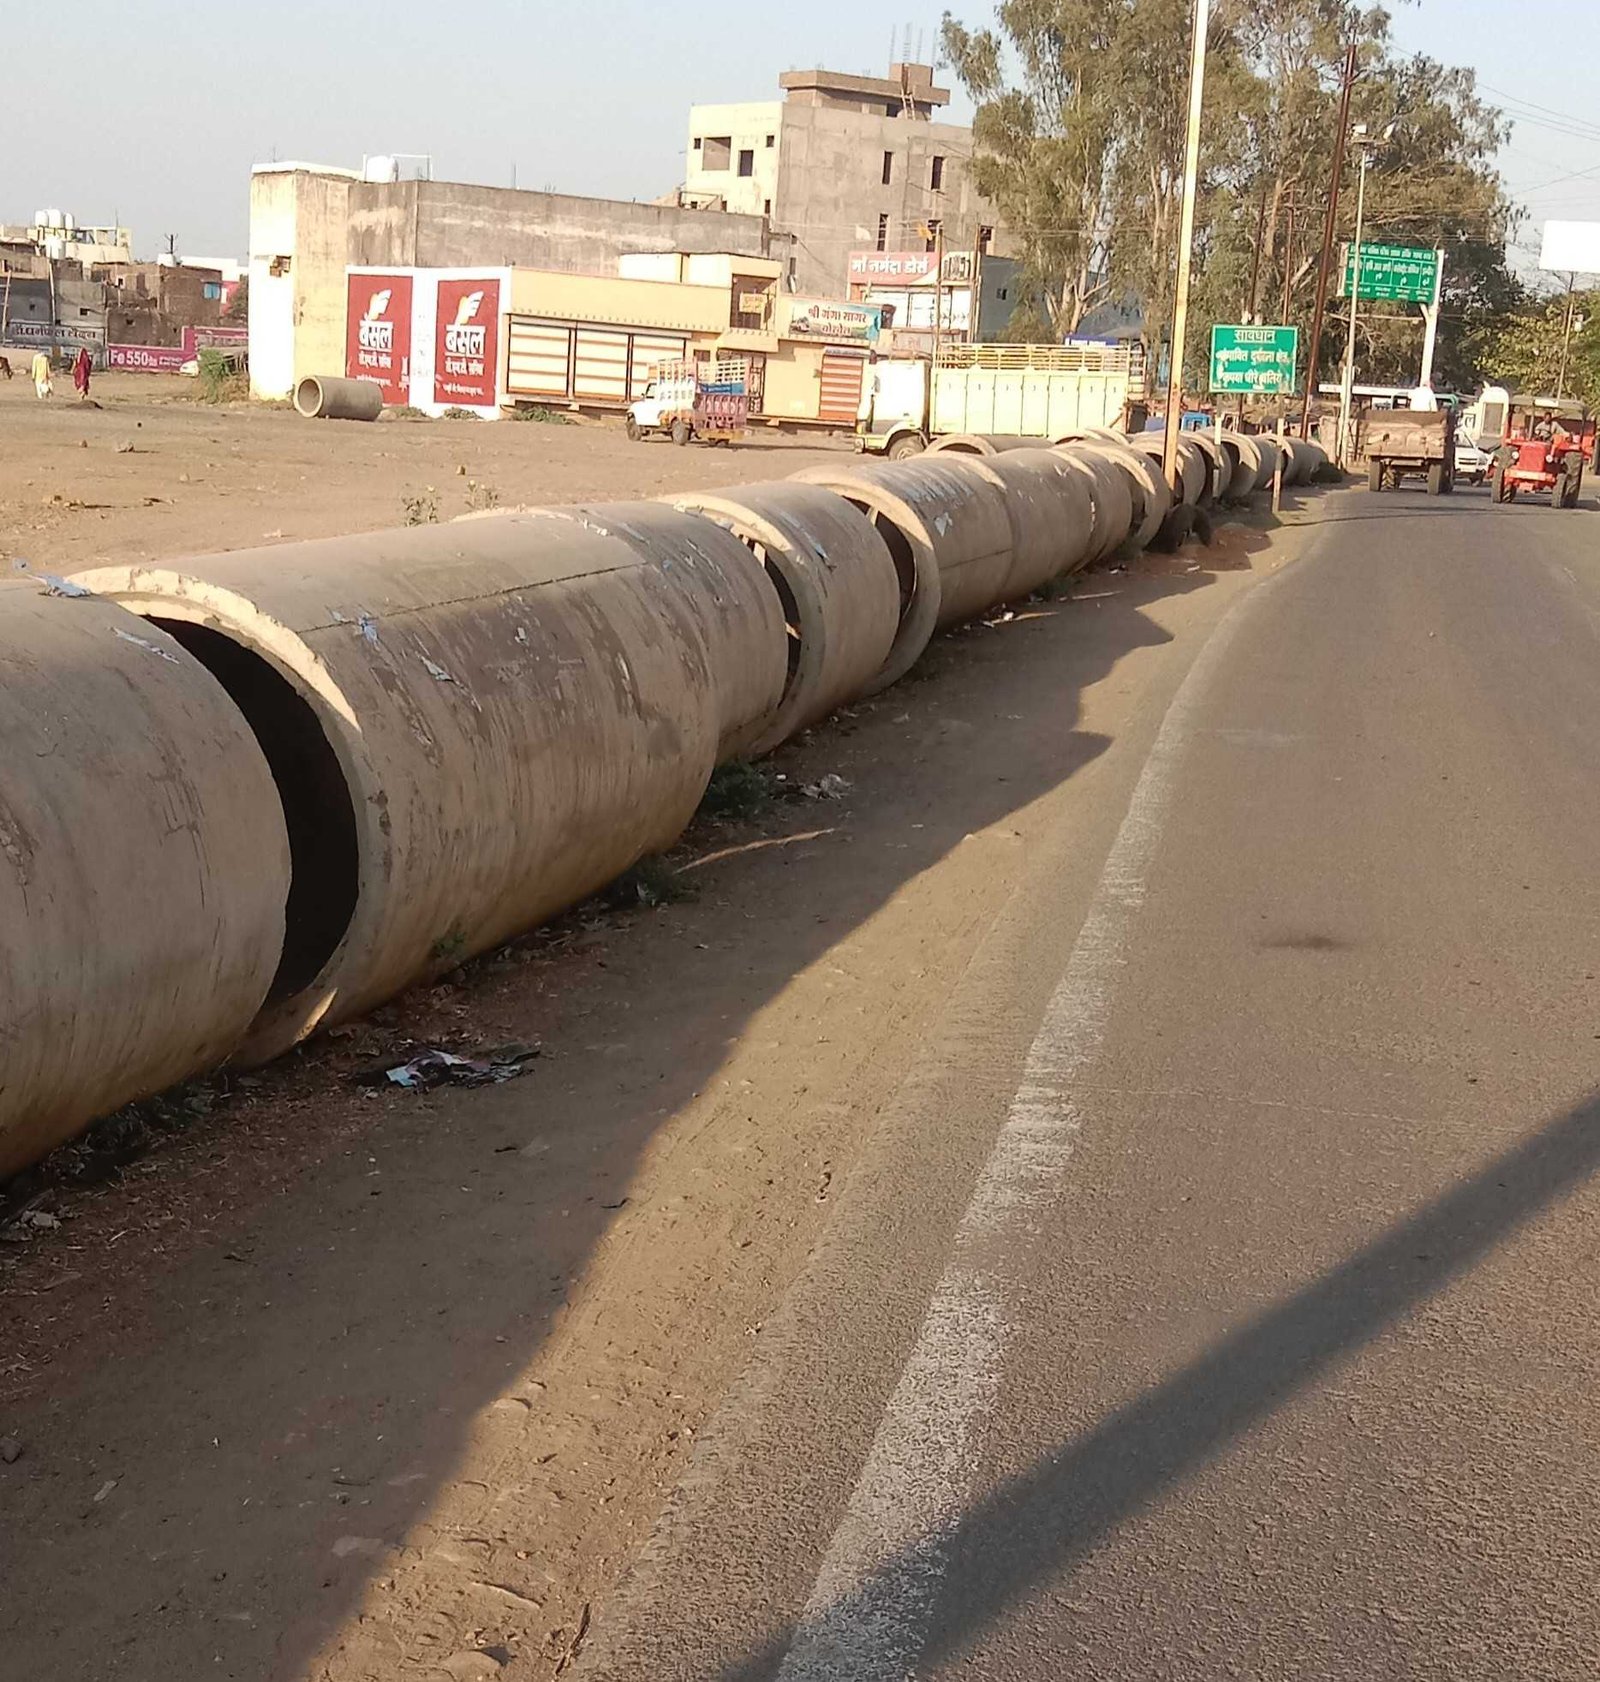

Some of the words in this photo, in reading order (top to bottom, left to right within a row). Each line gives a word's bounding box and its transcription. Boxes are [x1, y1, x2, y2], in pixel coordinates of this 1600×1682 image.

[808, 304, 820, 319] श्री
[821, 306, 841, 321] गंगा
[842, 311, 867, 324] सागर
[1234, 329, 1276, 341] सावधान
[110, 349, 125, 364] Fe
[126, 350, 148, 366] 550
